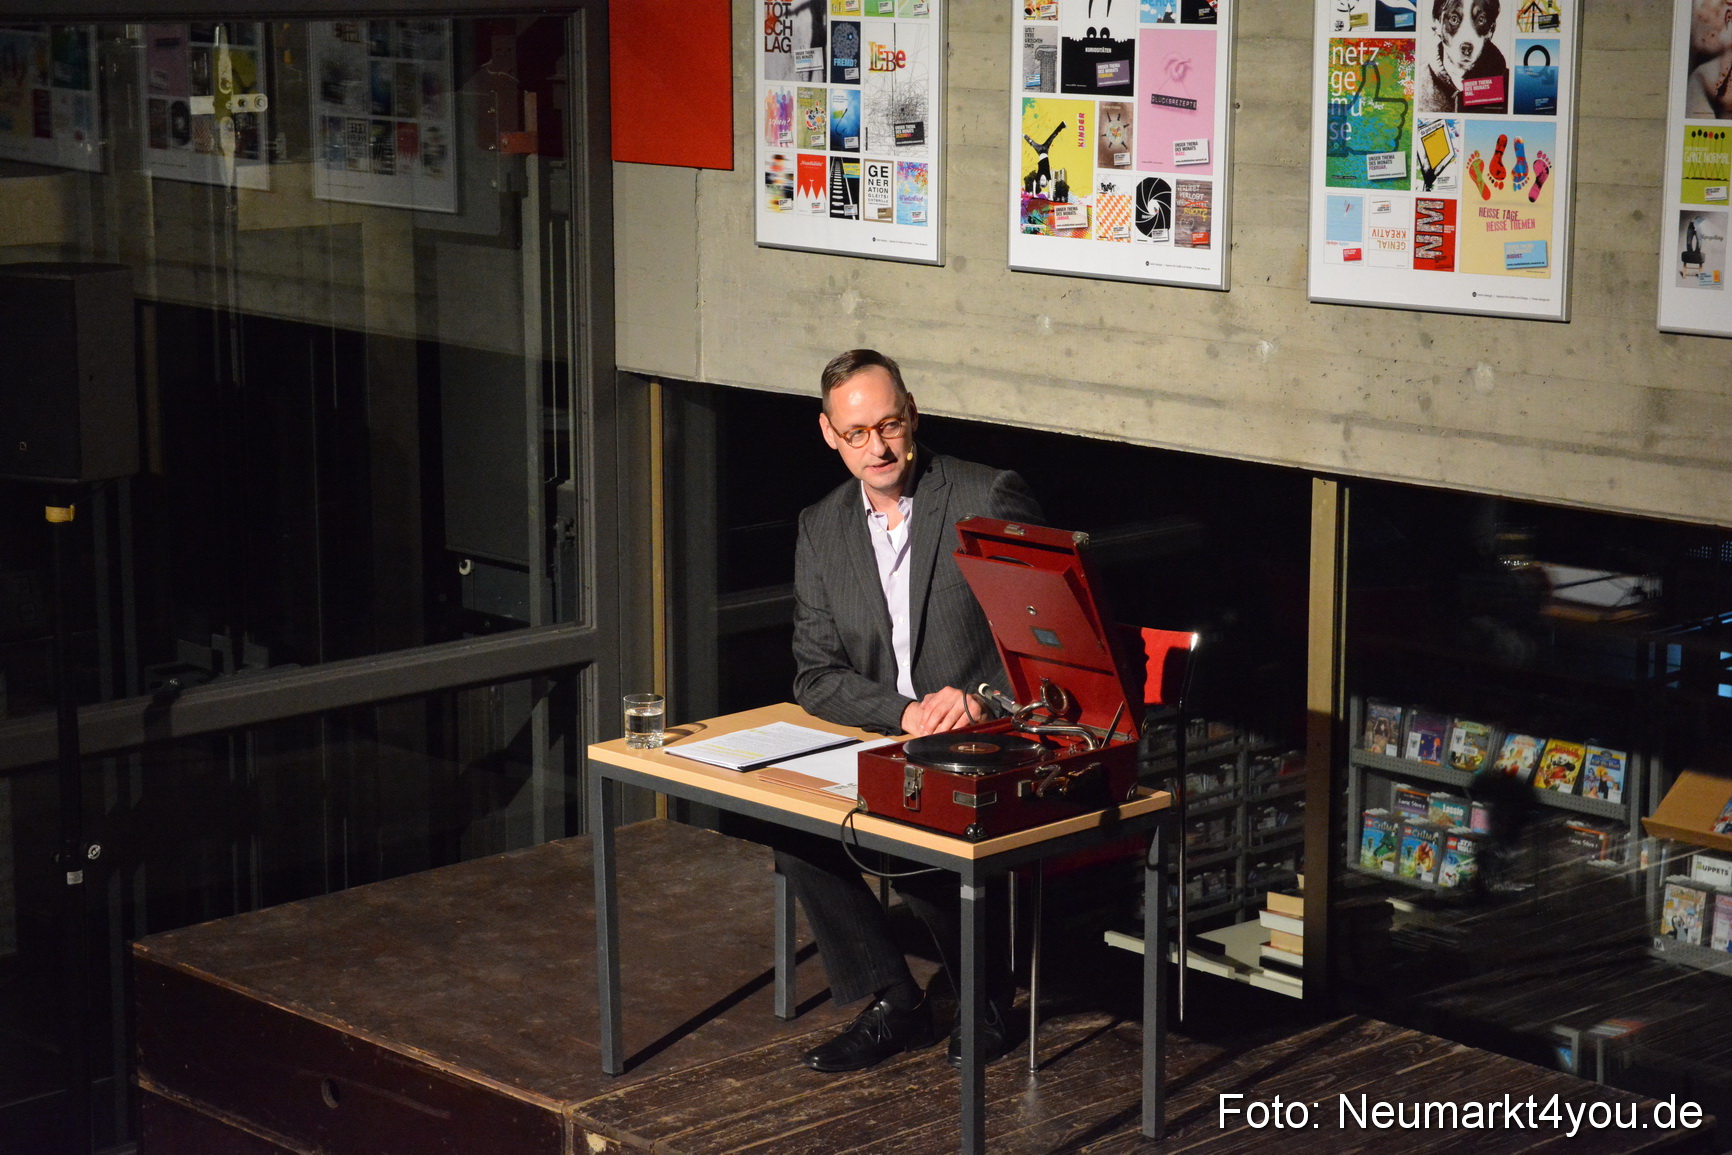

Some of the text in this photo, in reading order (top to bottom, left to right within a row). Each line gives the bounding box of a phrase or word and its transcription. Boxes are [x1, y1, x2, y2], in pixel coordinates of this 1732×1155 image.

[764, 2, 791, 19] TOT
[764, 36, 792, 54] LAG
[1332, 41, 1380, 65] netz
[833, 58, 858, 67] FREMD?
[1331, 70, 1356, 96] ge
[1331, 91, 1363, 117] mü
[1077, 113, 1085, 148] KINDER
[1329, 122, 1352, 141] se
[868, 165, 889, 178] GE
[868, 179, 889, 187] NER
[1478, 207, 1520, 221] HEISSE TAGE
[1486, 218, 1536, 232] HEISSE THEMEN
[1371, 229, 1407, 239] KREATIV
[1377, 240, 1406, 250] GENIAL
[1443, 804, 1464, 816] Lassie
